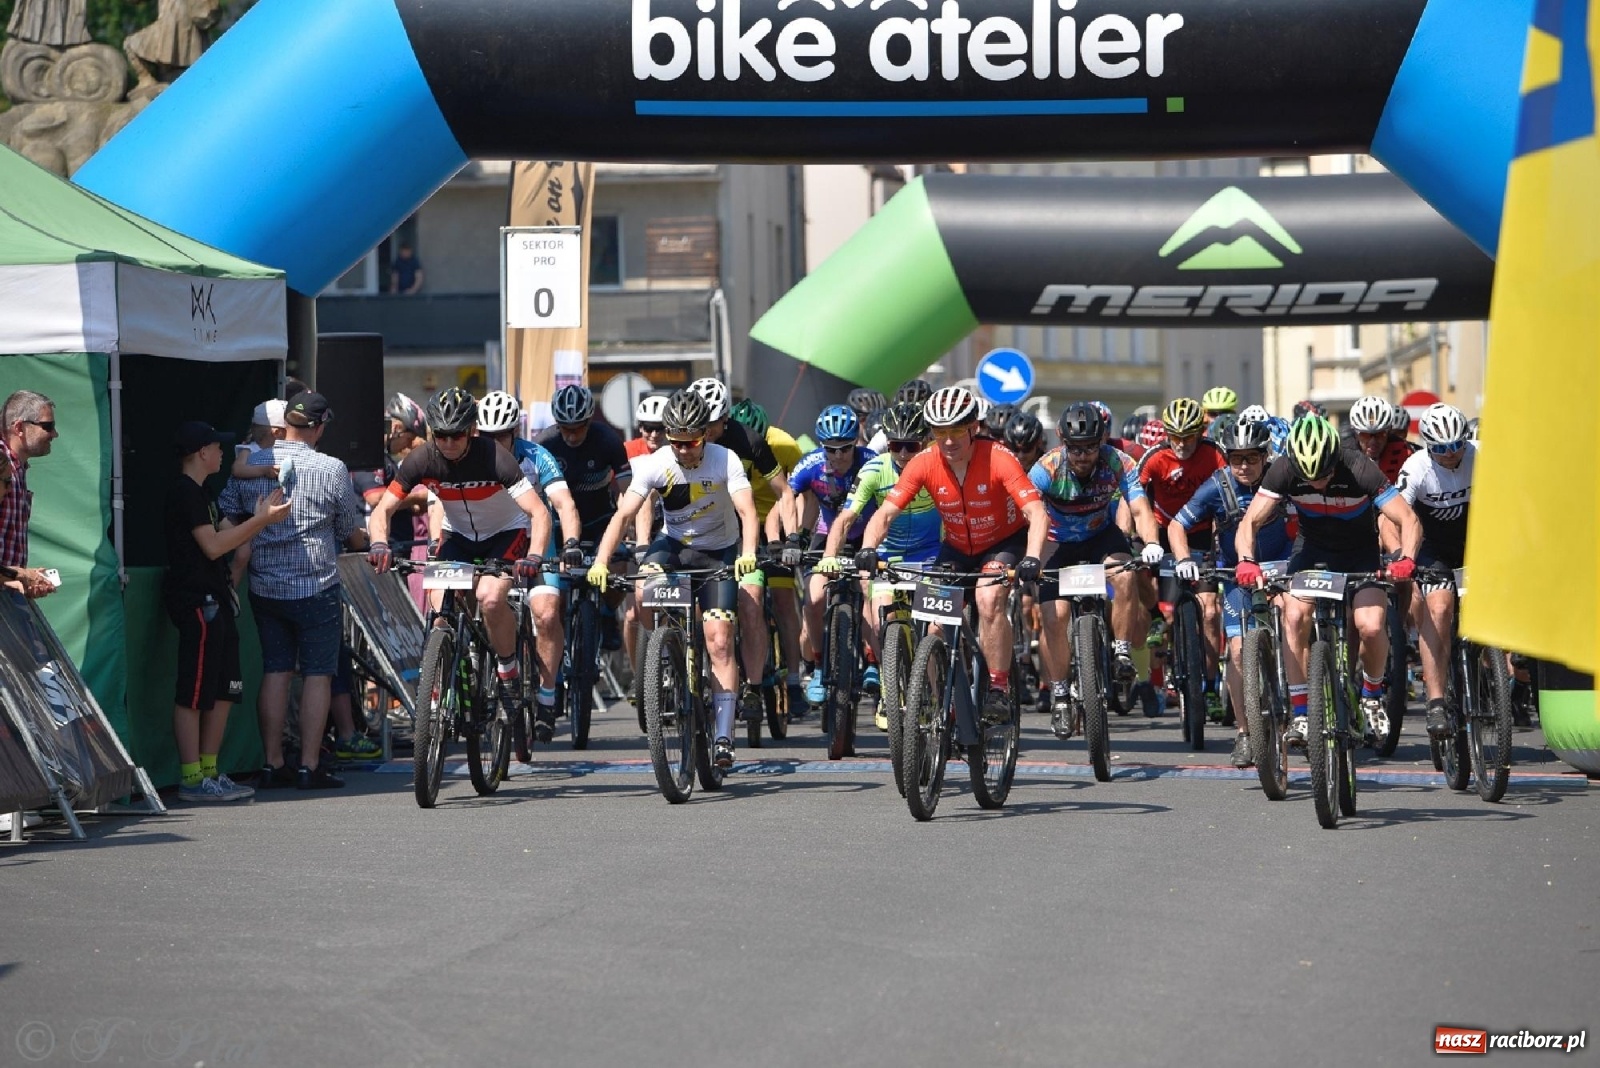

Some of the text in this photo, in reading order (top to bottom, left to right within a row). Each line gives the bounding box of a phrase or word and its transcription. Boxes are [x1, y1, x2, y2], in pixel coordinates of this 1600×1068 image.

[631, 0, 1185, 82] bike atelier
[522, 240, 564, 250] SEKTOR
[533, 256, 556, 266] PRO
[533, 287, 555, 318] 0
[1030, 278, 1439, 317] MERIDA
[439, 480, 497, 489] SCOTT
[432, 568, 464, 579] 1784
[1069, 573, 1096, 586] 1172
[652, 587, 681, 599] 1614
[922, 596, 953, 613] 1245
